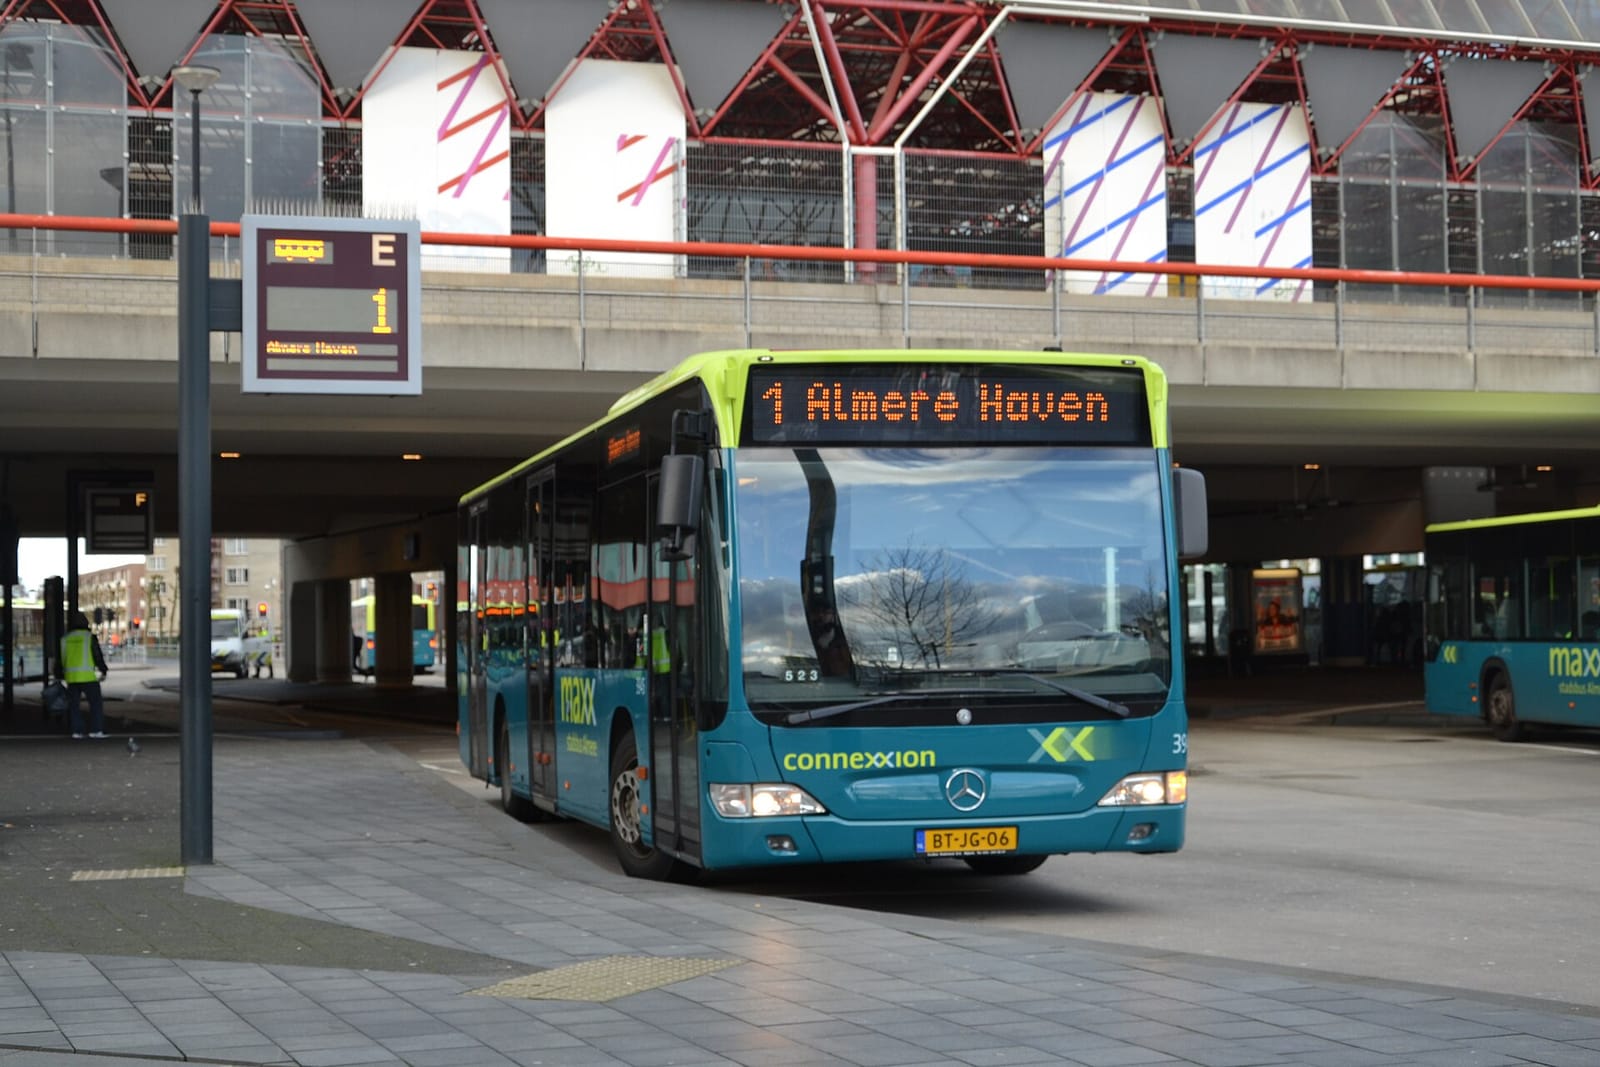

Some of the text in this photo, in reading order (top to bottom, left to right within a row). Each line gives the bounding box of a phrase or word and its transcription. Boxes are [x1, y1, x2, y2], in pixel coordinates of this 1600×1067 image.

[371, 234, 396, 267] E
[372, 287, 392, 334] 1
[762, 382, 1109, 424] 1 Almere Haven
[135, 493, 146, 507] F
[1549, 647, 1600, 678] max
[561, 676, 597, 726] maxx
[783, 750, 936, 771] connexxion
[932, 830, 1009, 849] BT-JG-06
